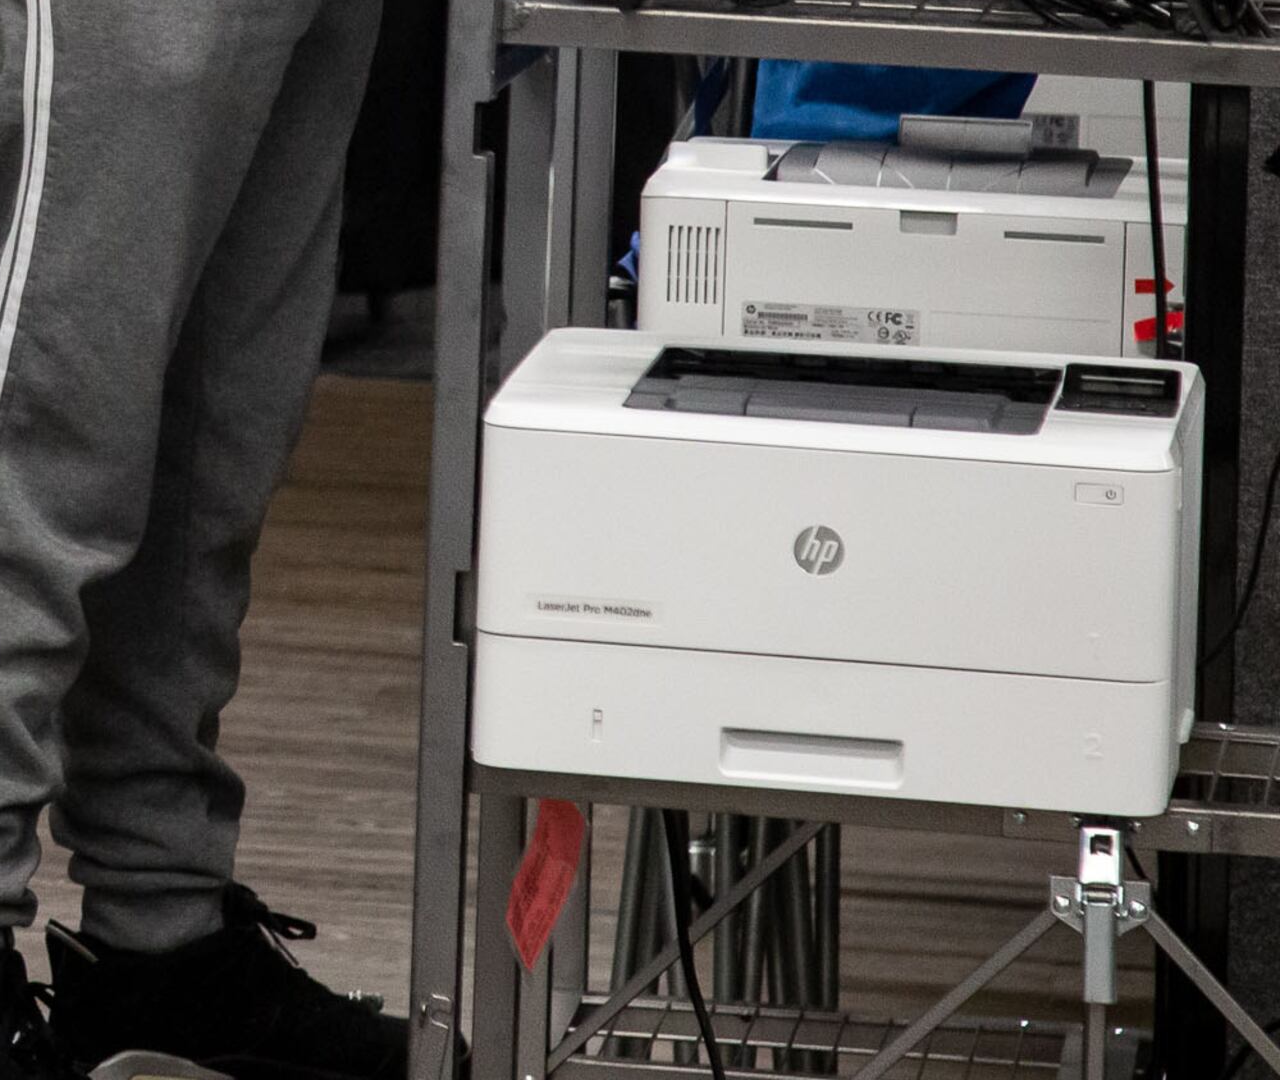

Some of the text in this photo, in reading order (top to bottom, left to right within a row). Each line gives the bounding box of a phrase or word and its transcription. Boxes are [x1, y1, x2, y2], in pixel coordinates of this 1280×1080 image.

[800, 524, 839, 575] hp
[537, 600, 580, 612] LaserJet
[583, 604, 601, 614] Pro
